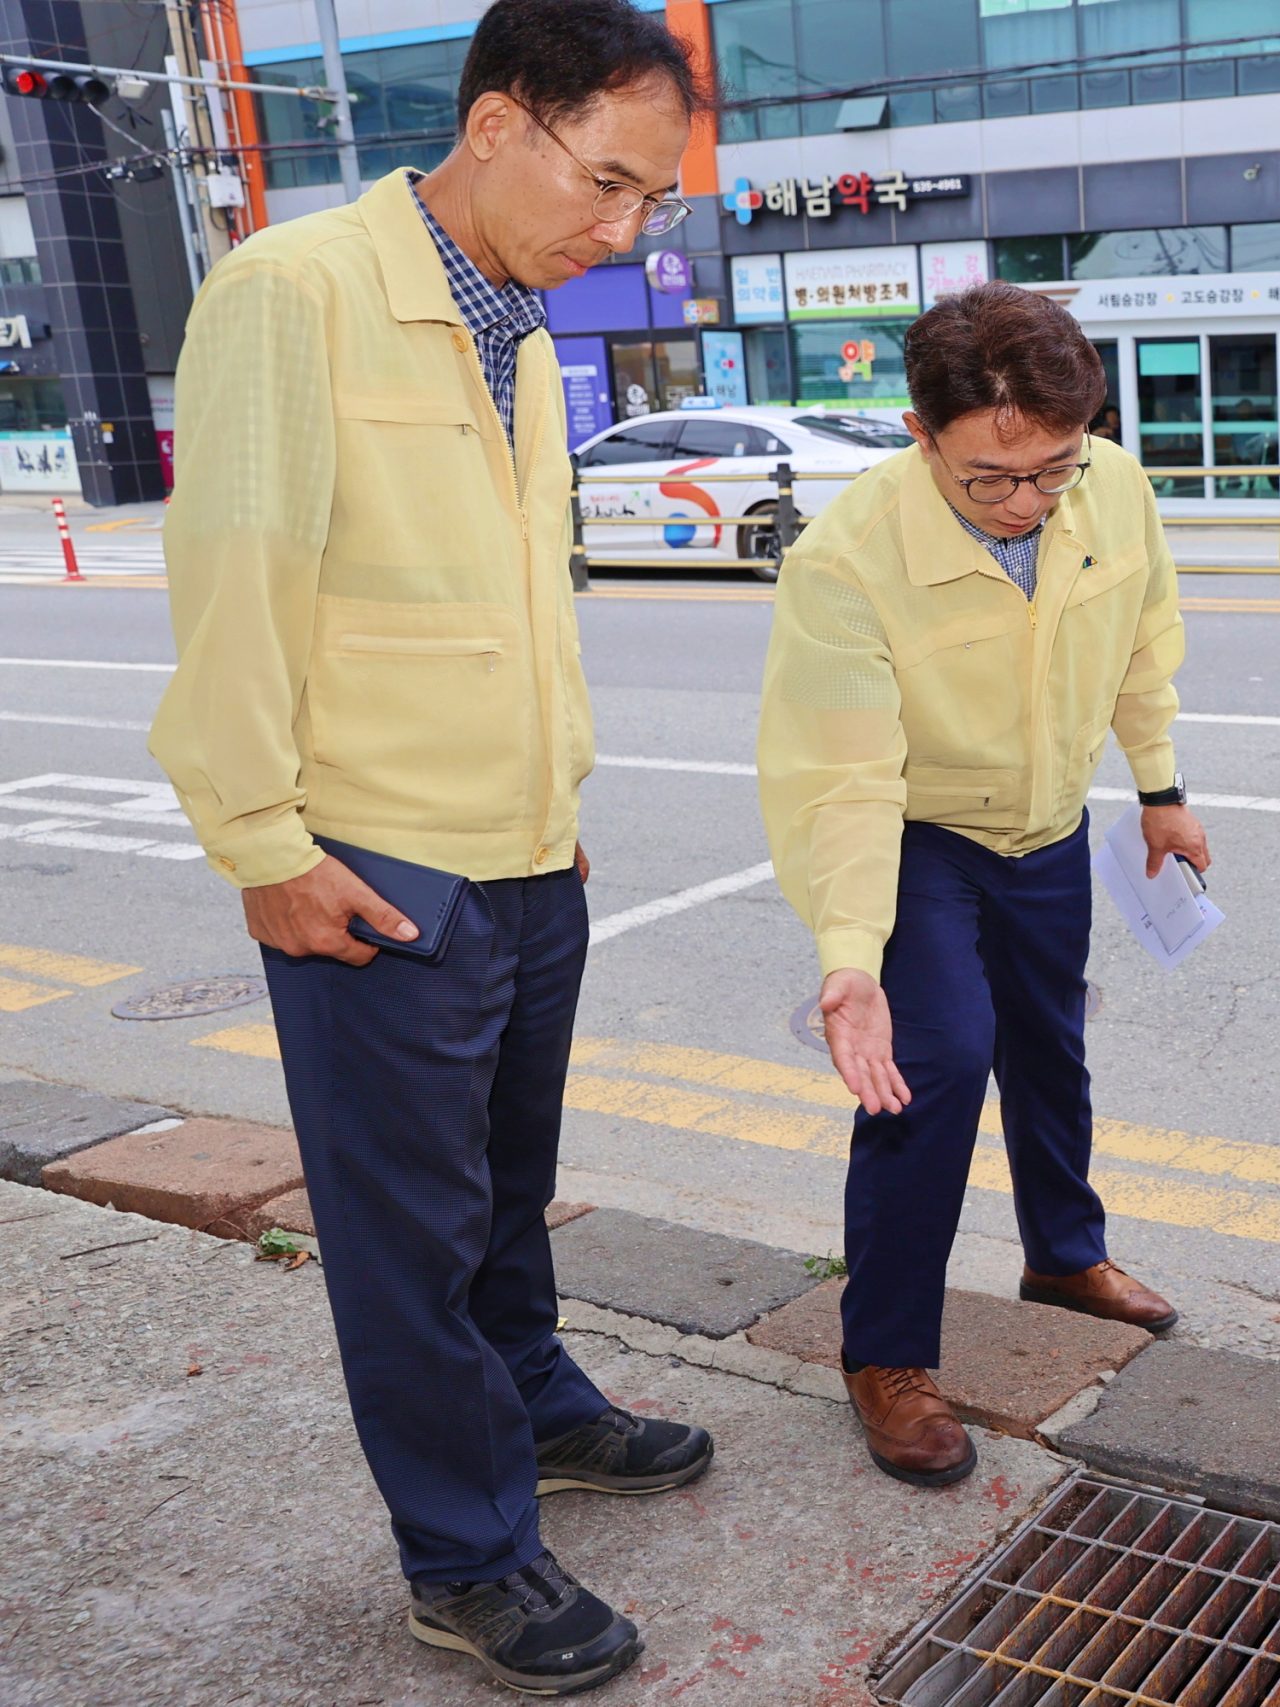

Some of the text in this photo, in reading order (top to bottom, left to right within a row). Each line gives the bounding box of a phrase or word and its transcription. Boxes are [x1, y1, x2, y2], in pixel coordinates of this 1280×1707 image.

[766, 170, 909, 218] 해남약국
[1097, 291, 1158, 308] 서림승강장
[1181, 288, 1244, 305] 고도승강장
